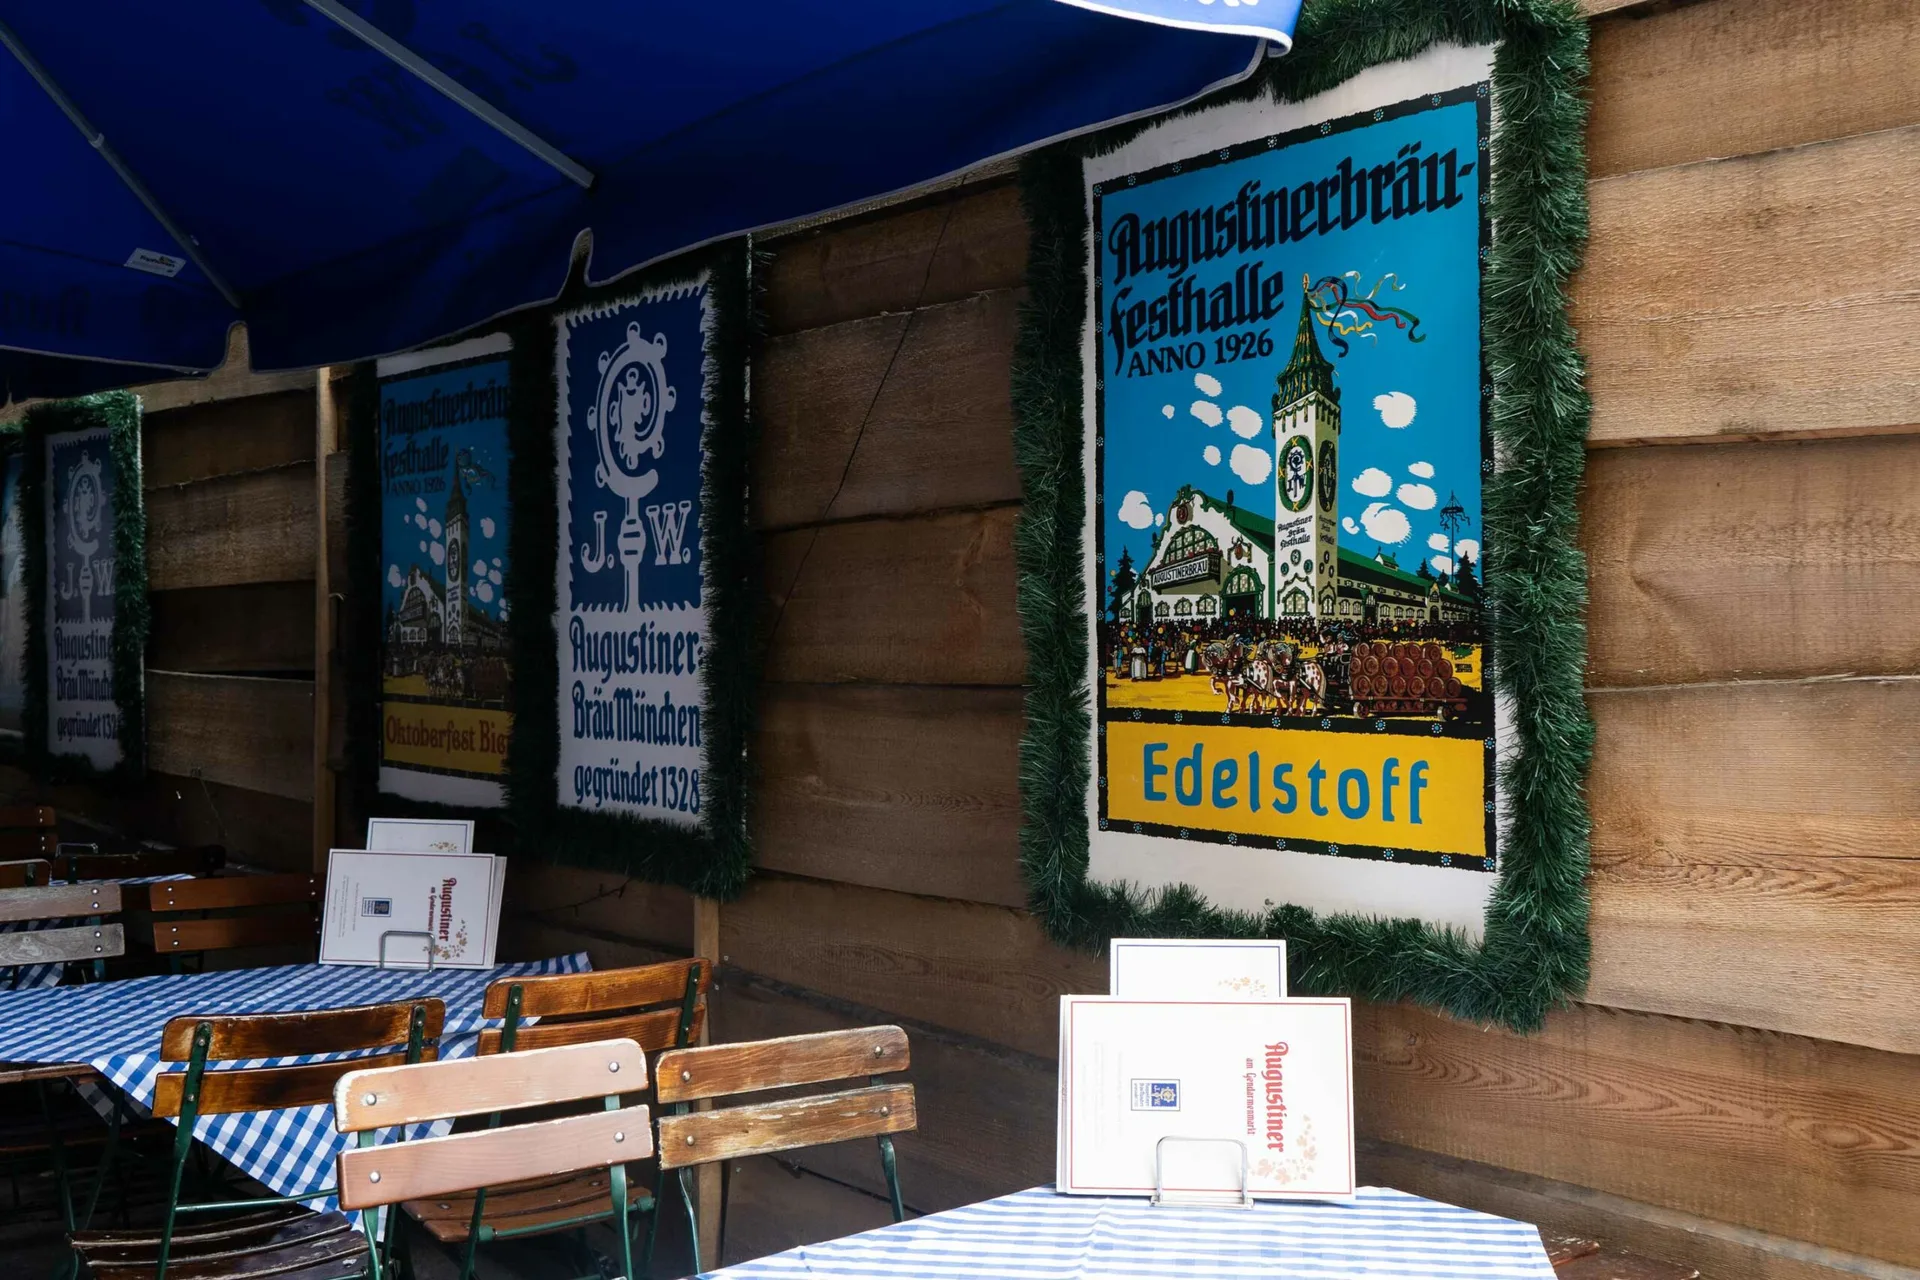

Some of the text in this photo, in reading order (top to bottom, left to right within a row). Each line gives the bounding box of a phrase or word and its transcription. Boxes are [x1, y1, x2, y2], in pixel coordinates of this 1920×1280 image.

[1127, 329, 1274, 379] ANNO 1926
[424, 475, 447, 493] 1926
[54, 626, 115, 667] Augustine
[77, 669, 116, 702] Münch
[101, 713, 118, 741] 132
[385, 714, 509, 755] Oktoberfest Bie
[572, 680, 701, 748] Bräu München
[574, 757, 701, 815] gegründet 1328
[1142, 742, 1430, 825] Edelstoff
[438, 877, 458, 942] Augustiner
[1243, 1072, 1257, 1135] Gendarmenmarkt
[1260, 1041, 1289, 1153] Augustiner
